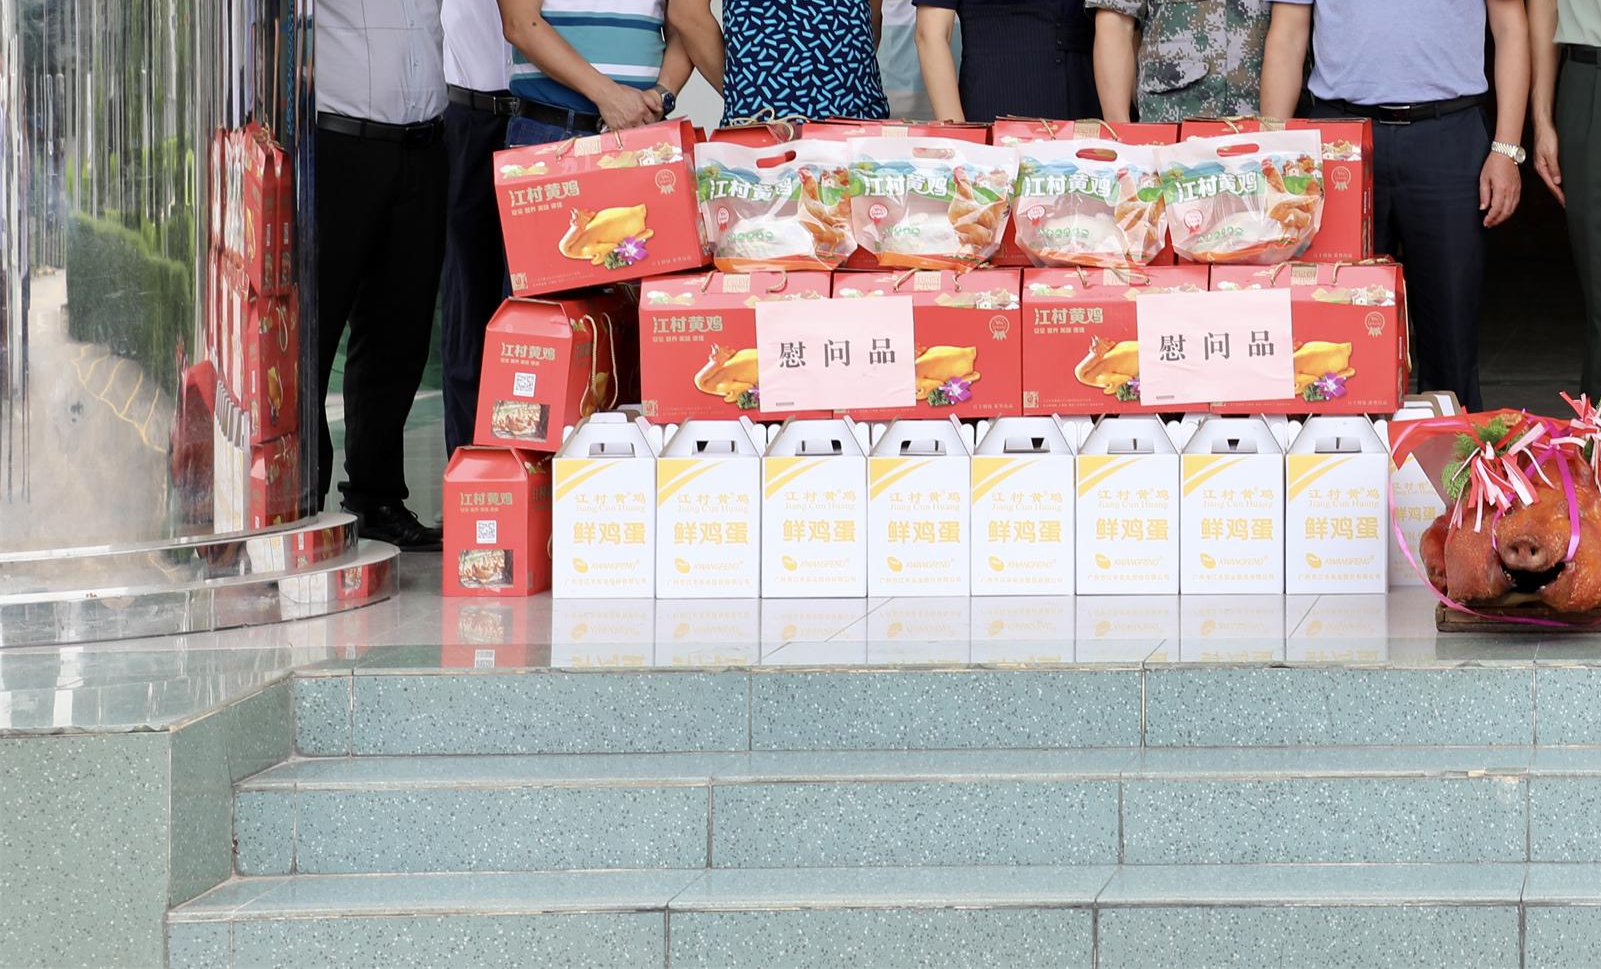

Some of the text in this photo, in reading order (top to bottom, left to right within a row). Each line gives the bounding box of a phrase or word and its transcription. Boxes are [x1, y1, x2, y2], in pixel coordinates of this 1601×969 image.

[508, 179, 581, 207] 江村黄鸡
[1023, 172, 1112, 198] 江村黄鸡
[1175, 171, 1259, 203] 江村黄鸡
[652, 314, 724, 334] 江村黄鸡
[1033, 306, 1105, 326] 江村黄鸡
[500, 341, 556, 361] 江村黄鸡
[779, 337, 897, 368] 慰问品
[1159, 330, 1275, 362] 慰问品
[459, 490, 513, 507] 江村黄鸡
[573, 520, 647, 546] 鲜鸡蛋
[673, 520, 749, 546] 鲜鸡蛋
[782, 517, 857, 544] 鲜鸡蛋
[887, 518, 961, 544] 鲜鸡蛋
[987, 518, 1062, 544] 鲜鸡蛋
[1095, 516, 1169, 543] 鲜鸡蛋
[1200, 516, 1274, 542] 鲜鸡蛋
[1304, 515, 1380, 541] 鲜鸡蛋
